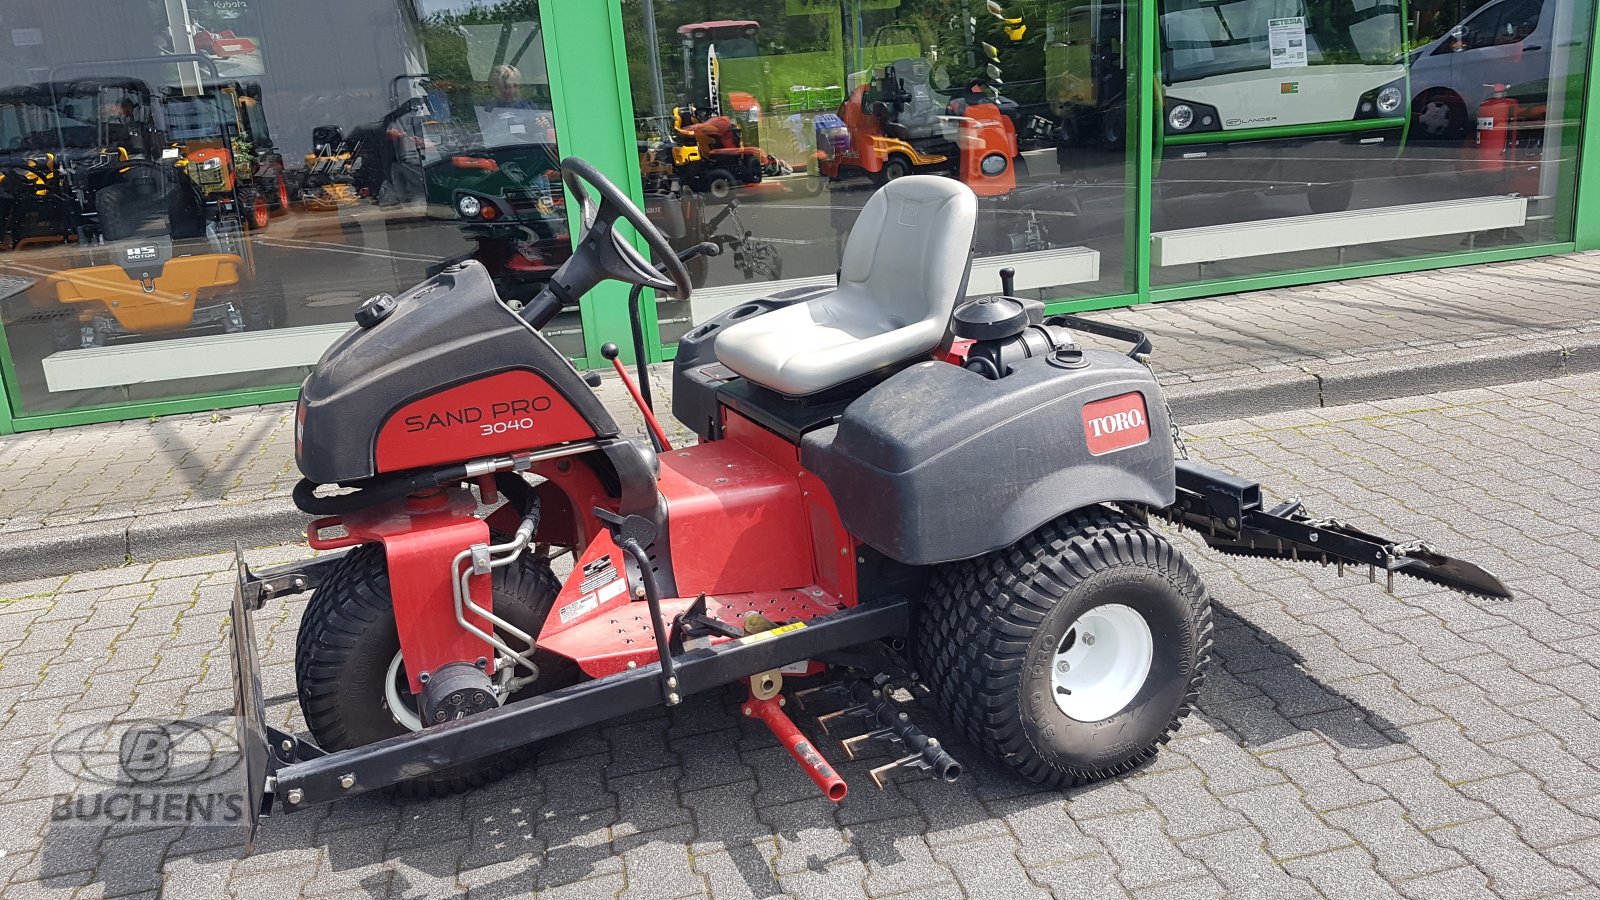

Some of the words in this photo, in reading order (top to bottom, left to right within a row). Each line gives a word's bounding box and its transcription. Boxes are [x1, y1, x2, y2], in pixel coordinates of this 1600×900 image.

[213, 0, 247, 8] Kubota
[405, 407, 482, 432] SAND
[492, 396, 551, 419] PRO
[480, 418, 534, 436] 3040
[1031, 634, 1055, 680] PRO
